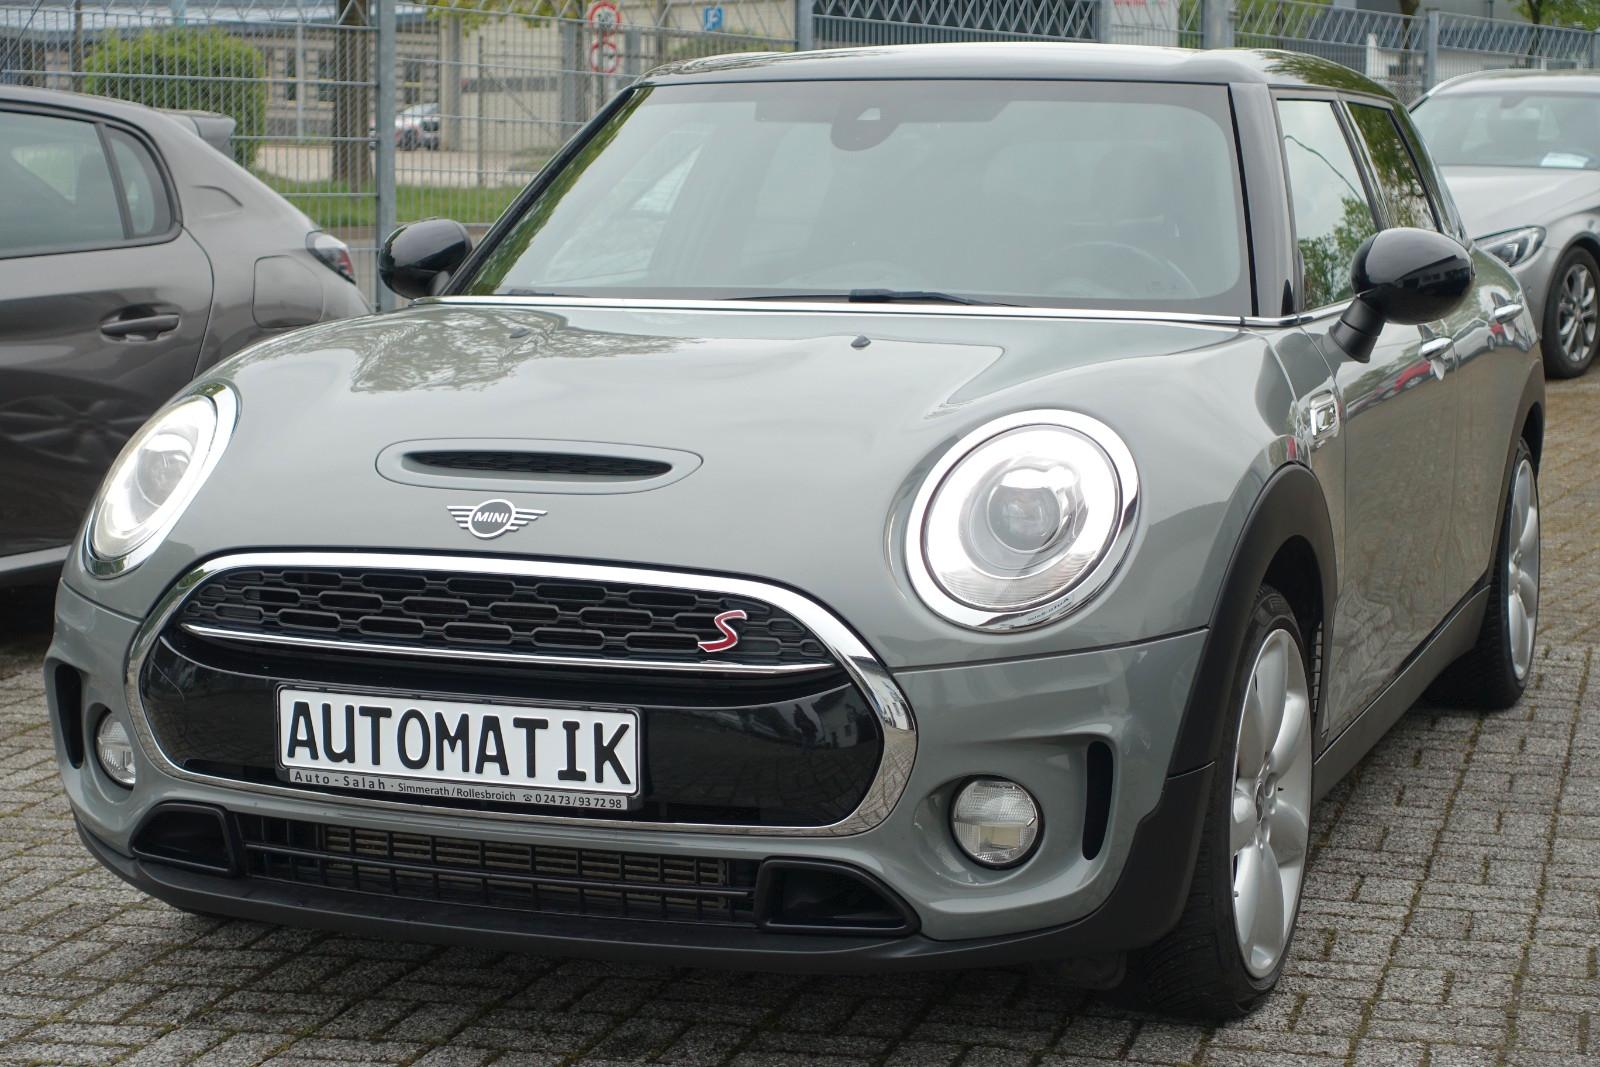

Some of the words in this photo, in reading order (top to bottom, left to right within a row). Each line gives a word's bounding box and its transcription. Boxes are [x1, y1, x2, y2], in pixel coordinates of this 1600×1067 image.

[474, 511, 509, 523] MINI
[697, 609, 748, 653] S
[287, 700, 631, 785] AUTOMATIK
